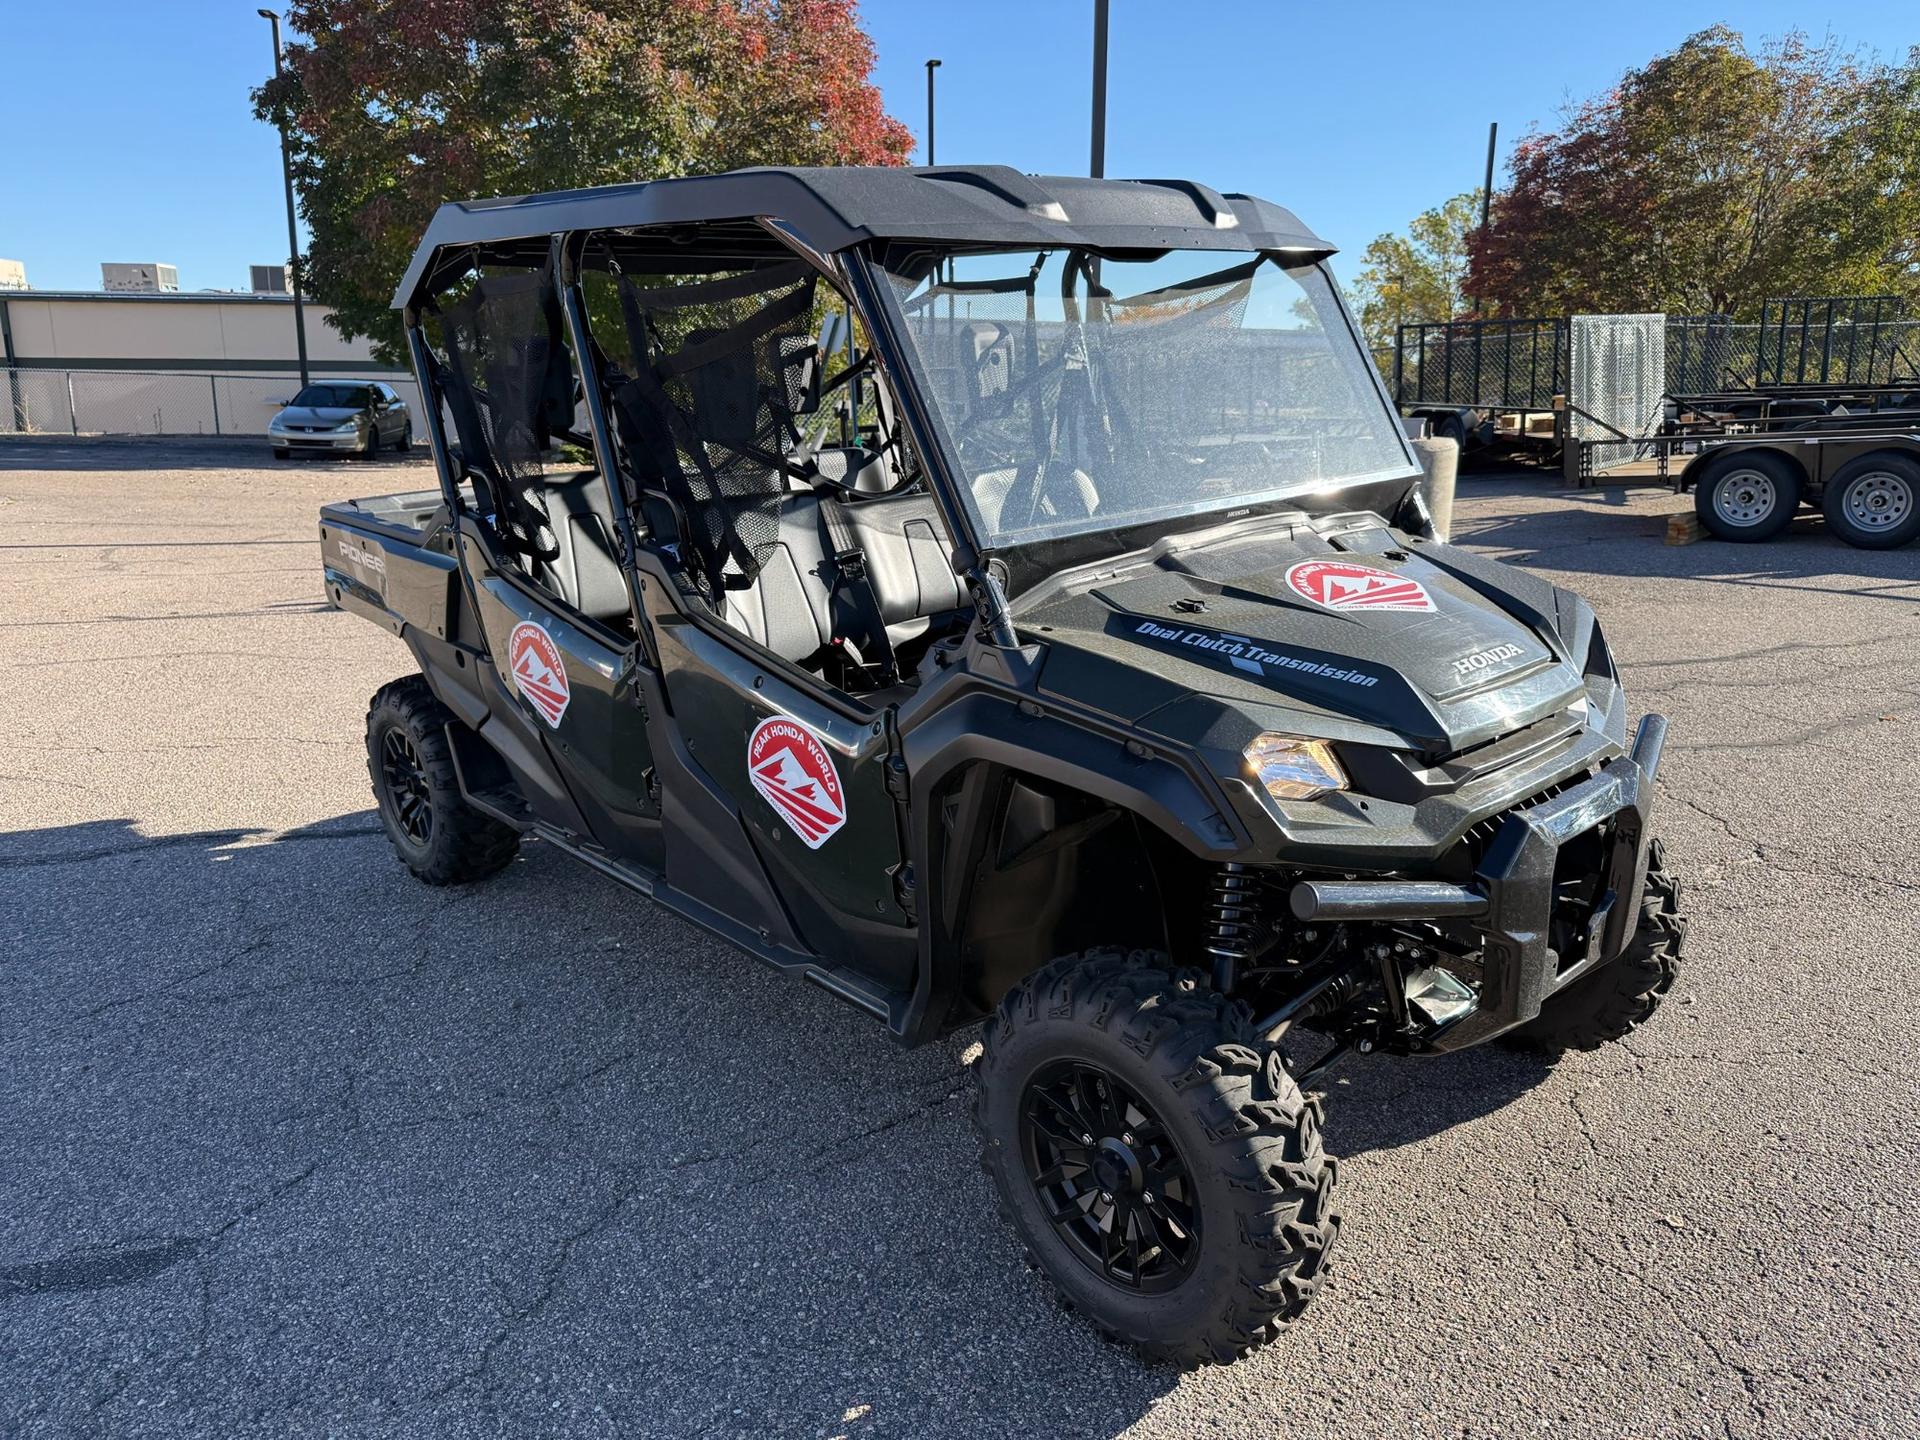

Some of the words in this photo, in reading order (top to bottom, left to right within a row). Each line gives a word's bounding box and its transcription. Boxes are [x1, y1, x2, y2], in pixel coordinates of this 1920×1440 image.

[1295, 564, 1330, 579] HONDA
[1329, 564, 1387, 577] WORLD
[519, 627, 541, 642] HONDA
[541, 636, 562, 677] WORLD
[1135, 621, 1178, 641] Dual
[1182, 632, 1245, 656] Clutch
[1243, 646, 1380, 688] Transmission
[1451, 643, 1525, 675] HONDA
[753, 730, 772, 759] PEAK
[771, 724, 805, 745] HONDA
[807, 740, 836, 793] WORLD
